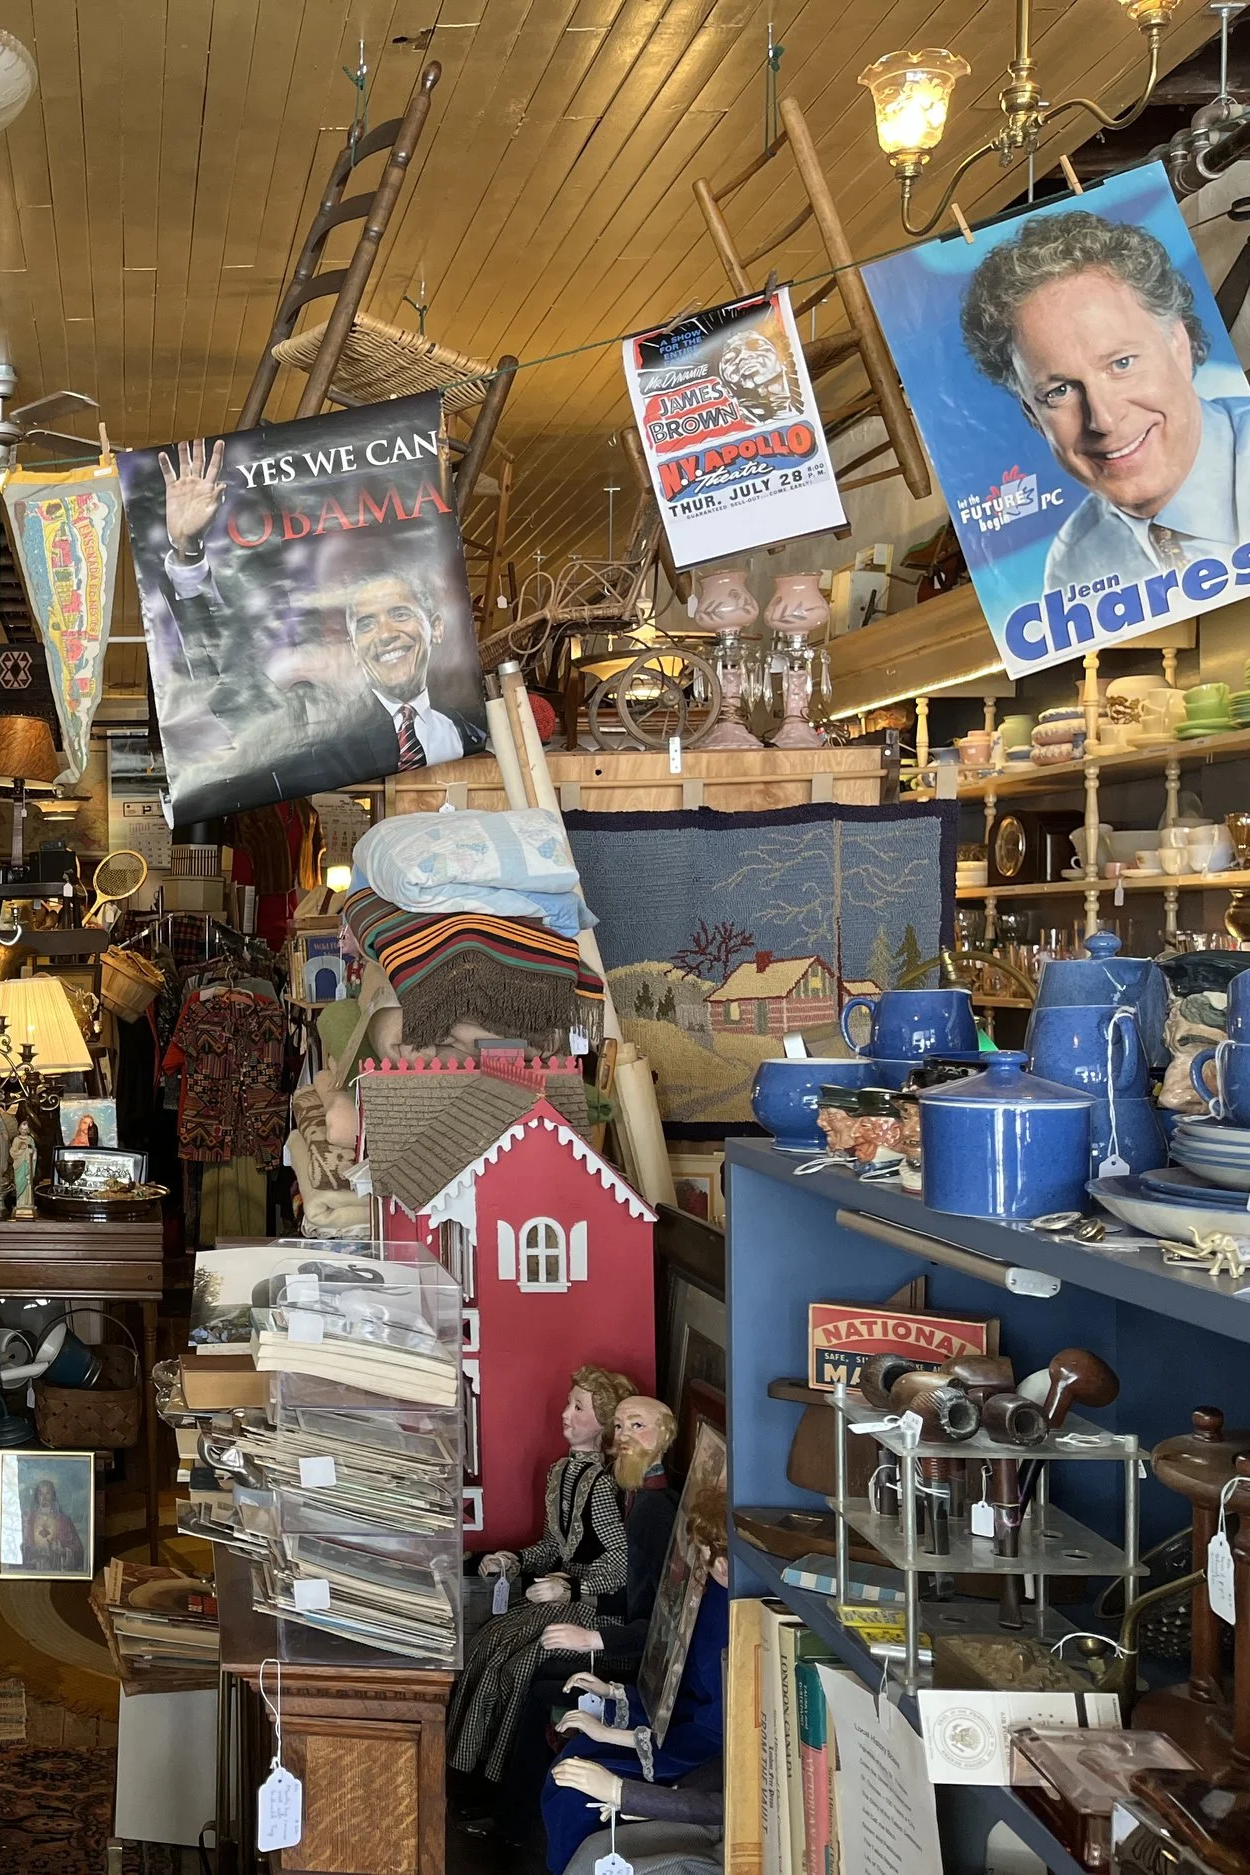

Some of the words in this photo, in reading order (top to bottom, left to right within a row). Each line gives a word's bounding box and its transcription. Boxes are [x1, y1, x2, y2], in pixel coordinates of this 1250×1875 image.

[659, 344, 679, 354] FOR
[683, 337, 703, 348] THE
[671, 329, 702, 344] SHOW
[659, 382, 724, 417] JAMES
[648, 402, 739, 444] BROWN
[236, 455, 296, 489] YES
[302, 444, 357, 478] WE
[365, 430, 440, 466] CAN
[704, 423, 814, 473] APOLLO
[694, 460, 774, 493] Theatre
[668, 495, 722, 518] THUR.
[729, 478, 771, 501] JULY
[779, 470, 803, 486] 28
[957, 499, 967, 510] let
[968, 493, 980, 506] the
[960, 490, 1026, 524] FUTURE
[1040, 487, 1064, 511] PC
[227, 476, 453, 548] OBAMA
[686, 505, 728, 520] GUARANTEED
[1066, 573, 1121, 603] Jean
[780, 1654, 790, 1717] LONDON
[854, 1722, 870, 1738] Local
[870, 1733, 887, 1756] History
[886, 1748, 901, 1770] Books
